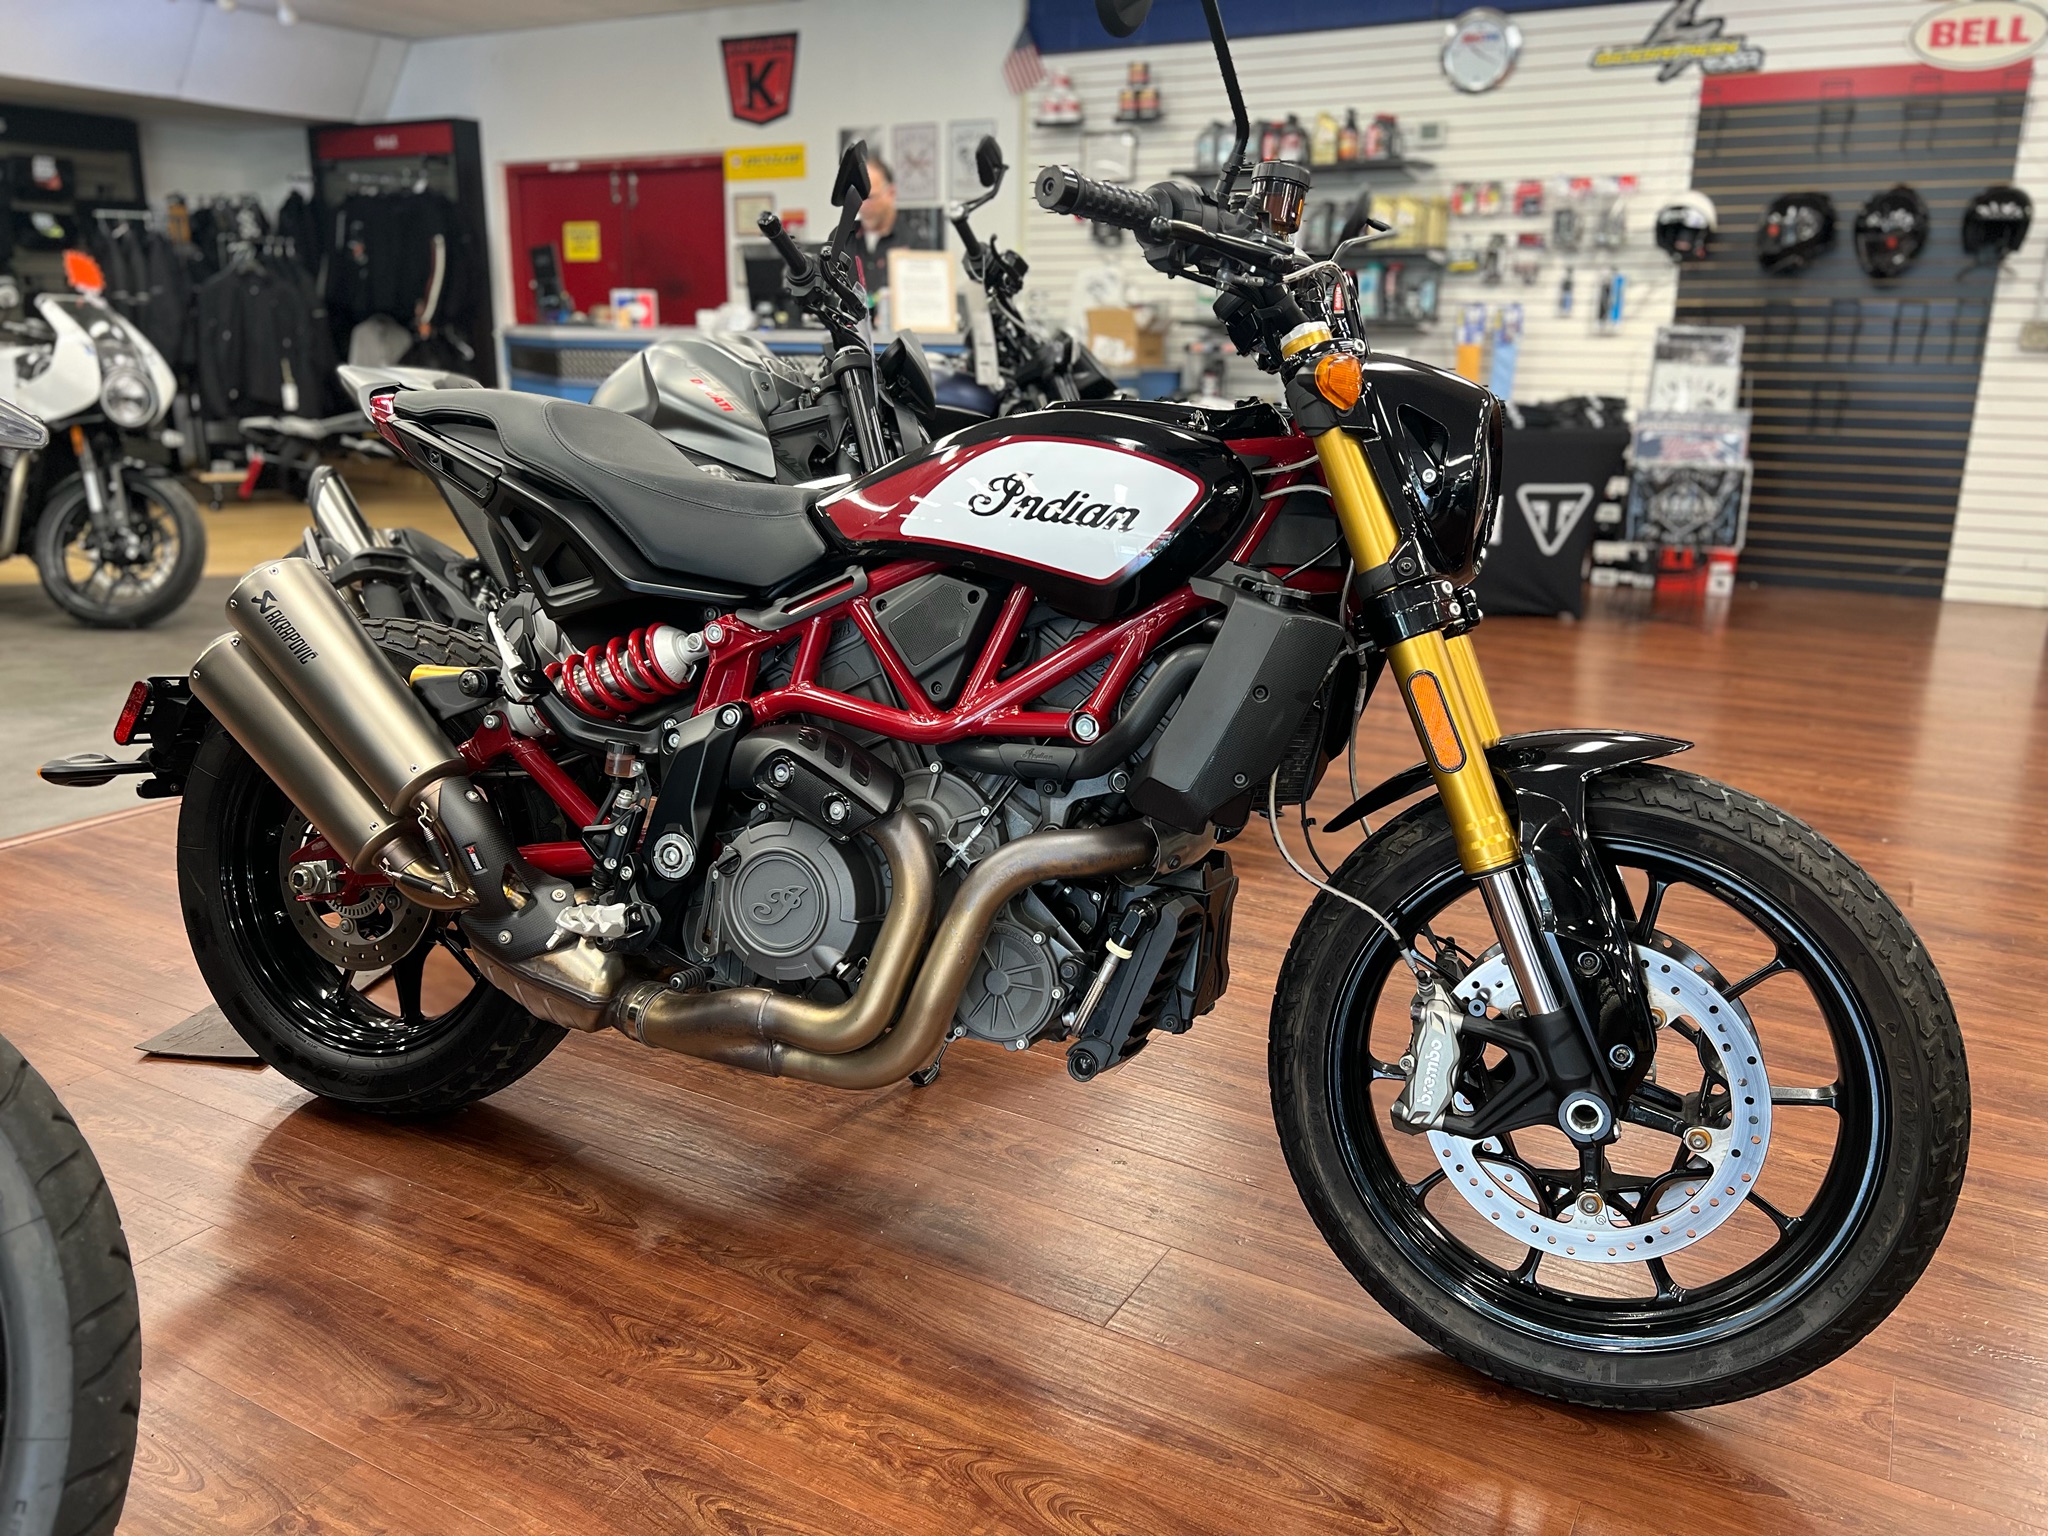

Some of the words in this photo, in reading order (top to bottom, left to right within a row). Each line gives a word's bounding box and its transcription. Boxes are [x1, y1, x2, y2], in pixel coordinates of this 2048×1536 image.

[1929, 14, 2032, 48] BELL
[689, 378, 734, 411] DCATI
[968, 471, 1141, 533] Indian
[1416, 1039, 1443, 1106] brembo
